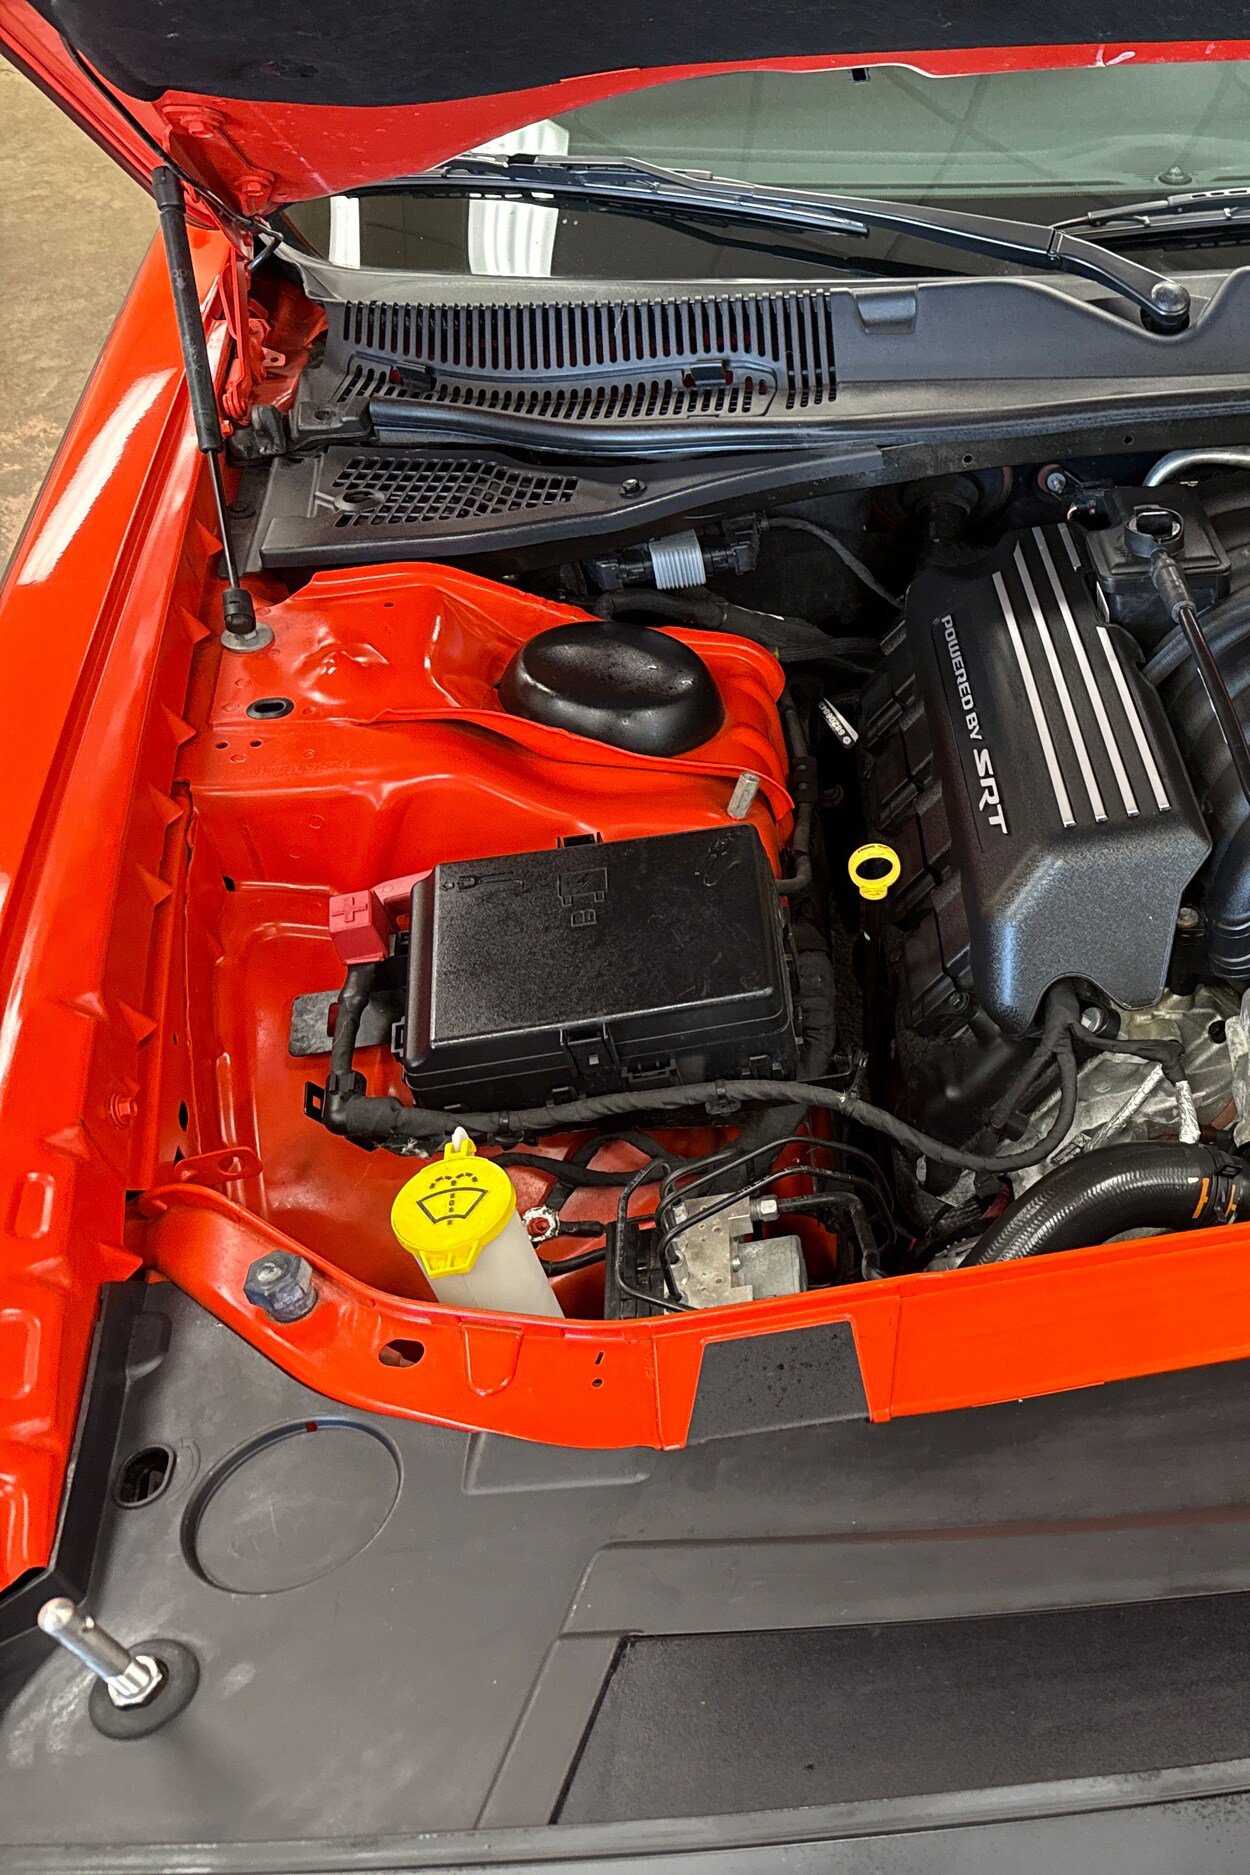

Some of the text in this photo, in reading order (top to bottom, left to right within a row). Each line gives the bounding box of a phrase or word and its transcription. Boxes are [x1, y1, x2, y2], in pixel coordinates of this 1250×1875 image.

[940, 614, 1009, 836] POWERED BY SRT
